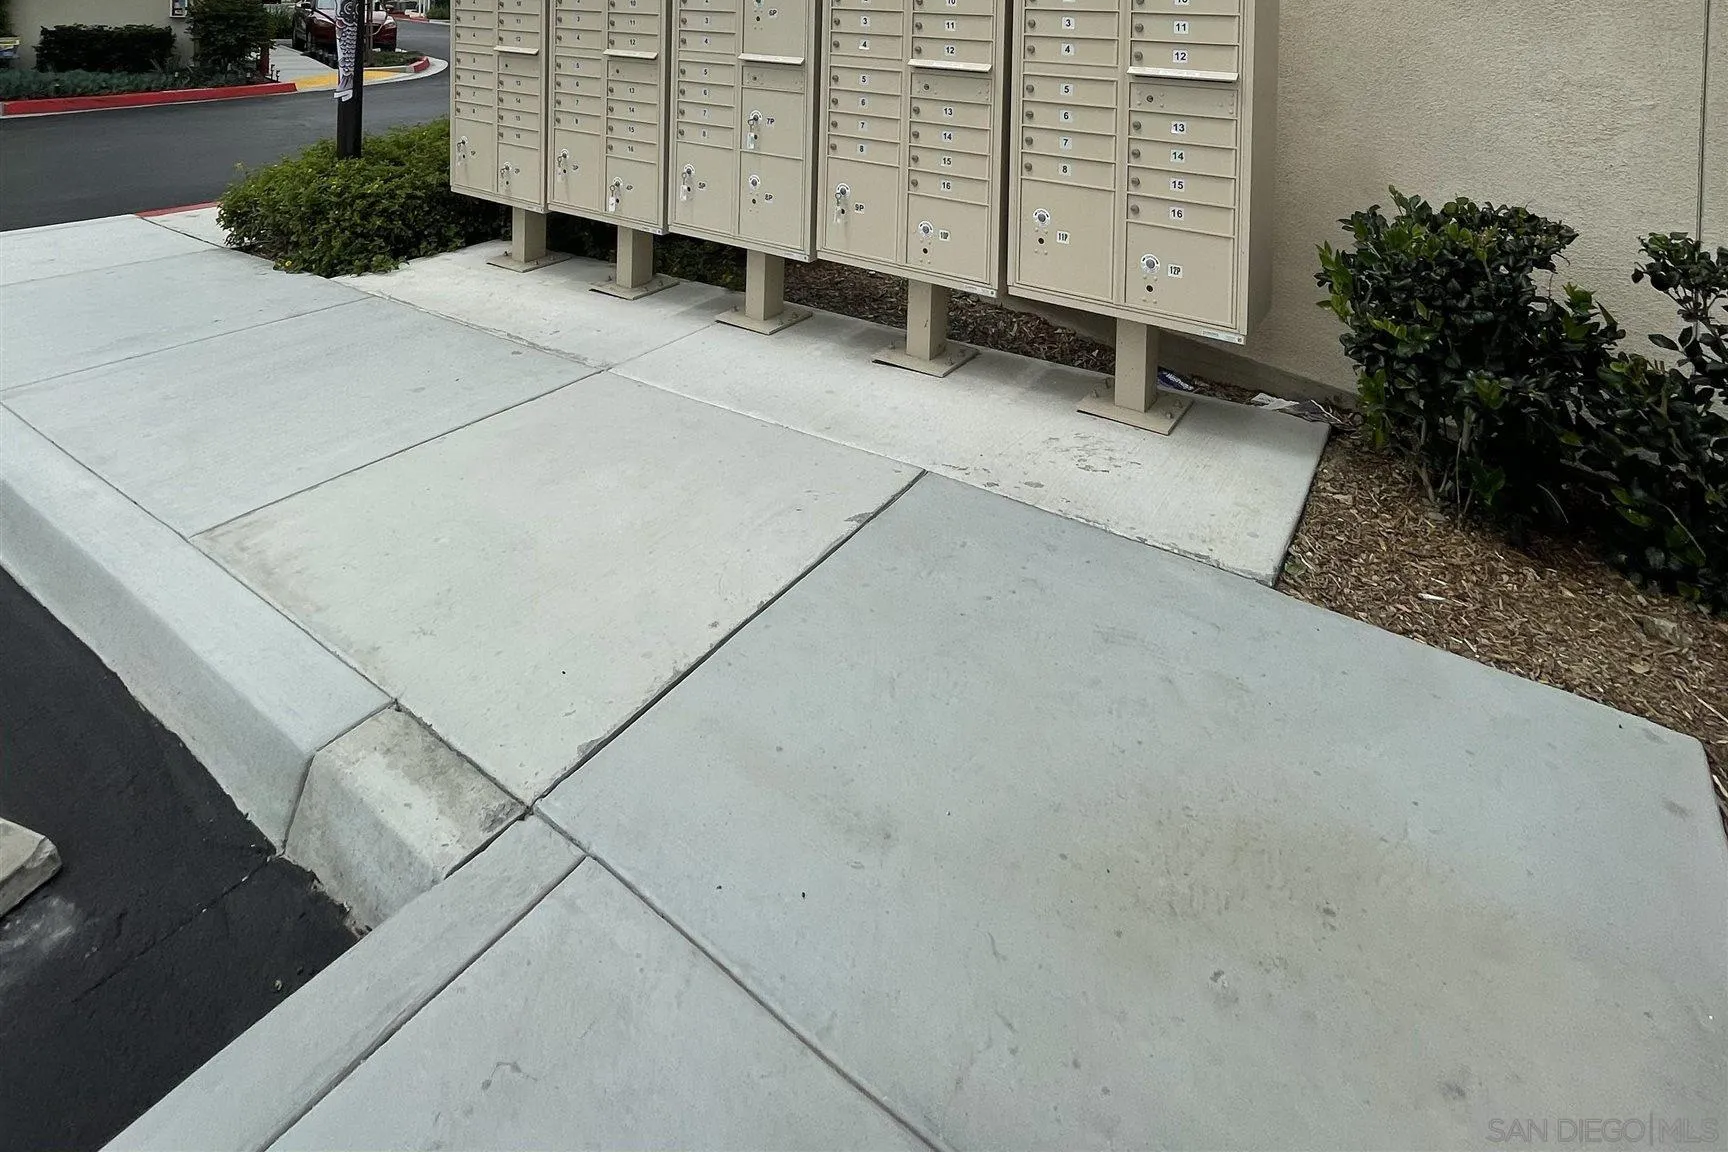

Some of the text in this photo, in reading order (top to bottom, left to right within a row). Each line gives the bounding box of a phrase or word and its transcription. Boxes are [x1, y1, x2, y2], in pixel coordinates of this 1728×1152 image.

[863, 17, 868, 25] 3
[1065, 18, 1071, 27] 3
[1176, 23, 1186, 32] 11
[946, 46, 955, 54] 12
[1064, 45, 1071, 53] 4
[1174, 51, 1187, 61] 12
[861, 75, 867, 83] 5
[1064, 85, 1070, 94] 5
[861, 98, 866, 106] 6
[944, 107, 953, 116] 13
[1063, 111, 1069, 120] 6
[766, 117, 775, 125] 7P
[860, 121, 865, 129] 7
[1173, 123, 1185, 132] 13
[943, 132, 952, 141] 14
[1063, 138, 1069, 146] 7
[859, 145, 864, 153] 8
[1172, 151, 1184, 161] 14
[943, 157, 952, 165] 15
[1062, 165, 1068, 174] 8
[942, 181, 951, 190] 16
[1172, 180, 1184, 190] 15
[764, 193, 773, 201] 8P
[855, 203, 864, 211] 9P
[1171, 209, 1183, 219] 16
[1170, 266, 1181, 275] 12P
